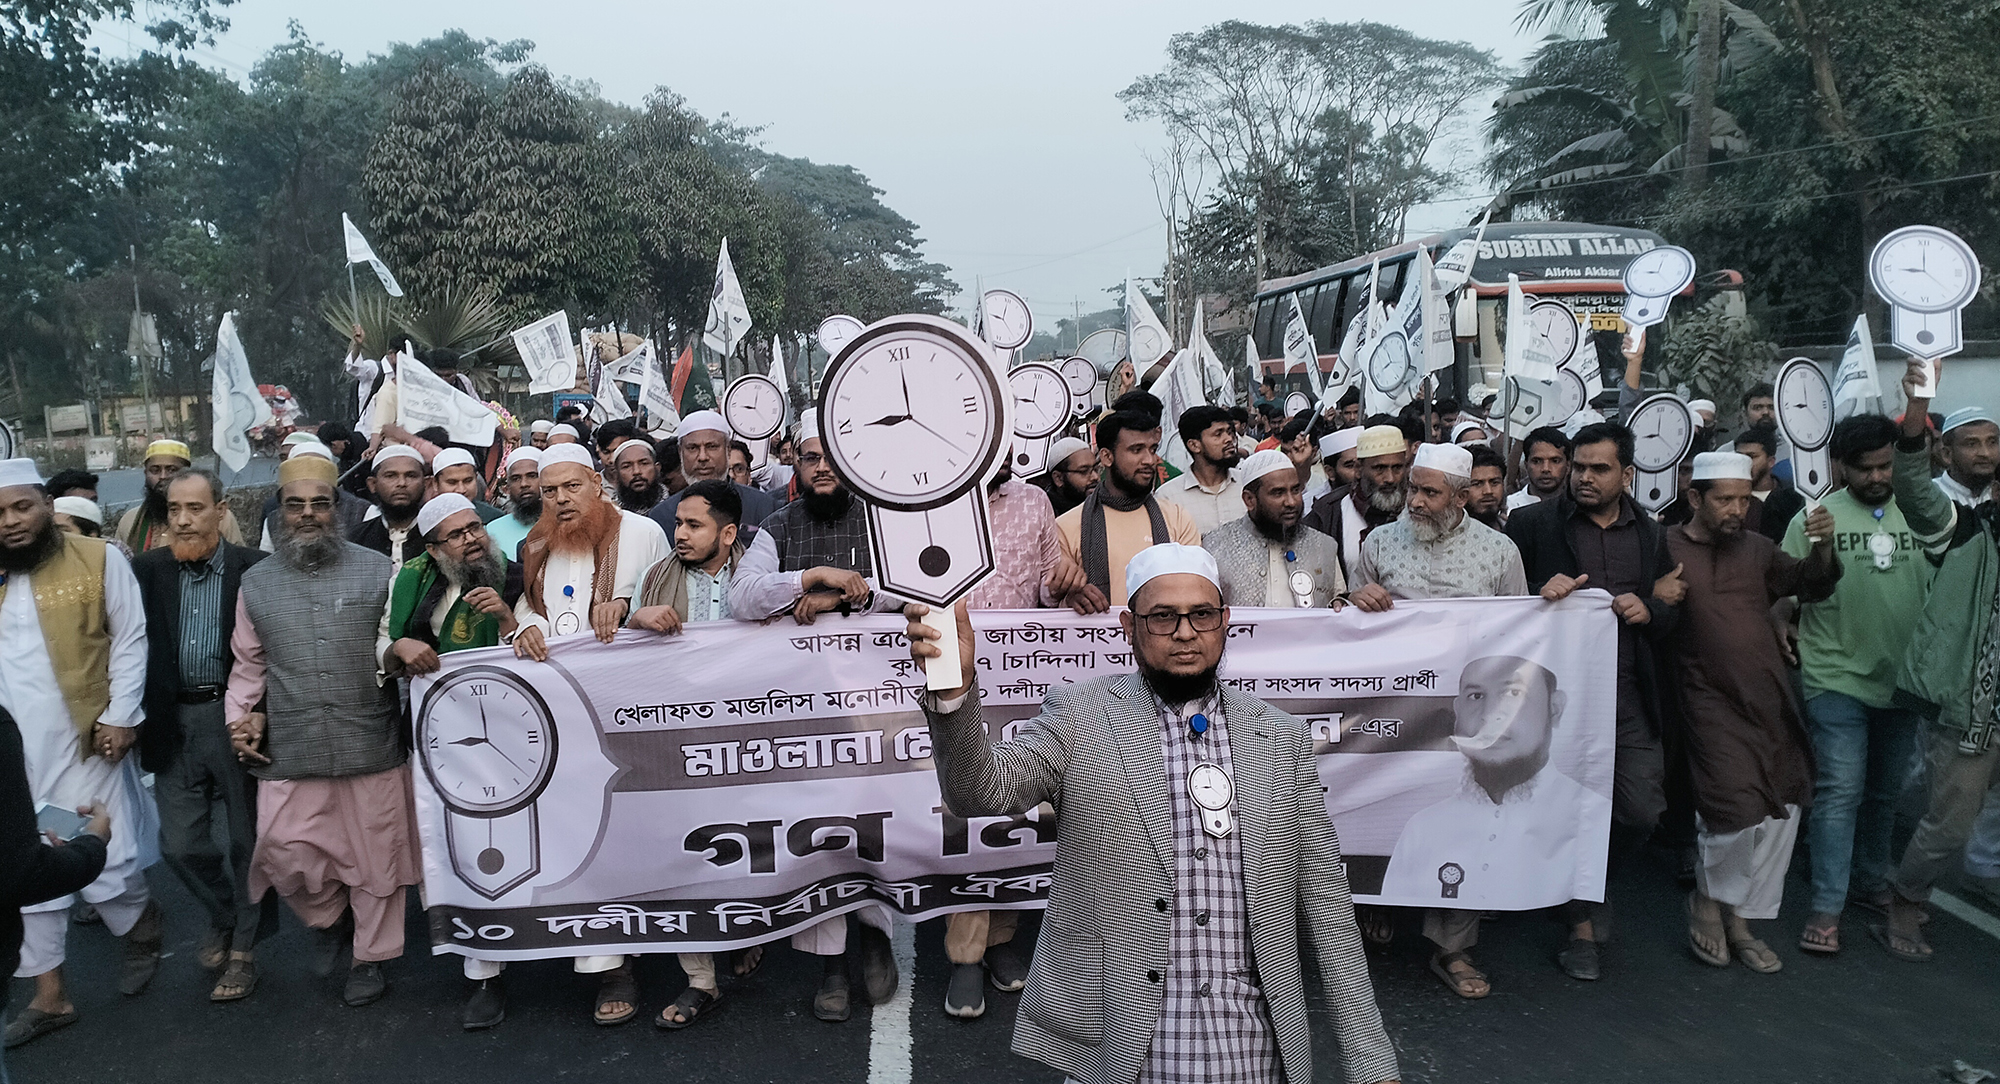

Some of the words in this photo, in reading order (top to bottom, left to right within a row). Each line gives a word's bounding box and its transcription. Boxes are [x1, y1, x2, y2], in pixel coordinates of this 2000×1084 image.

[1478, 238, 1573, 260] SUBHAN
[1579, 238, 1656, 256] ALLAH
[1584, 266, 1621, 278] Akbar
[789, 633, 864, 654] আসন্ন
[982, 621, 1068, 645] জাতীয়
[1076, 627, 1127, 644] সংস
[1003, 649, 1096, 671] [চান্দিনা]
[614, 701, 717, 726] খেলাফত
[723, 689, 816, 718] মজলিস
[996, 678, 1051, 699] দলীয়
[1264, 677, 1324, 693] সংসদ
[1329, 676, 1386, 692] সদস্য
[1392, 670, 1439, 691] প্রার্থী
[681, 730, 884, 778] মাওলানা
[683, 810, 893, 876] গণ
[451, 916, 515, 942] ১০
[535, 904, 698, 939] দলীয়
[707, 879, 934, 934] নির্বাচনী
